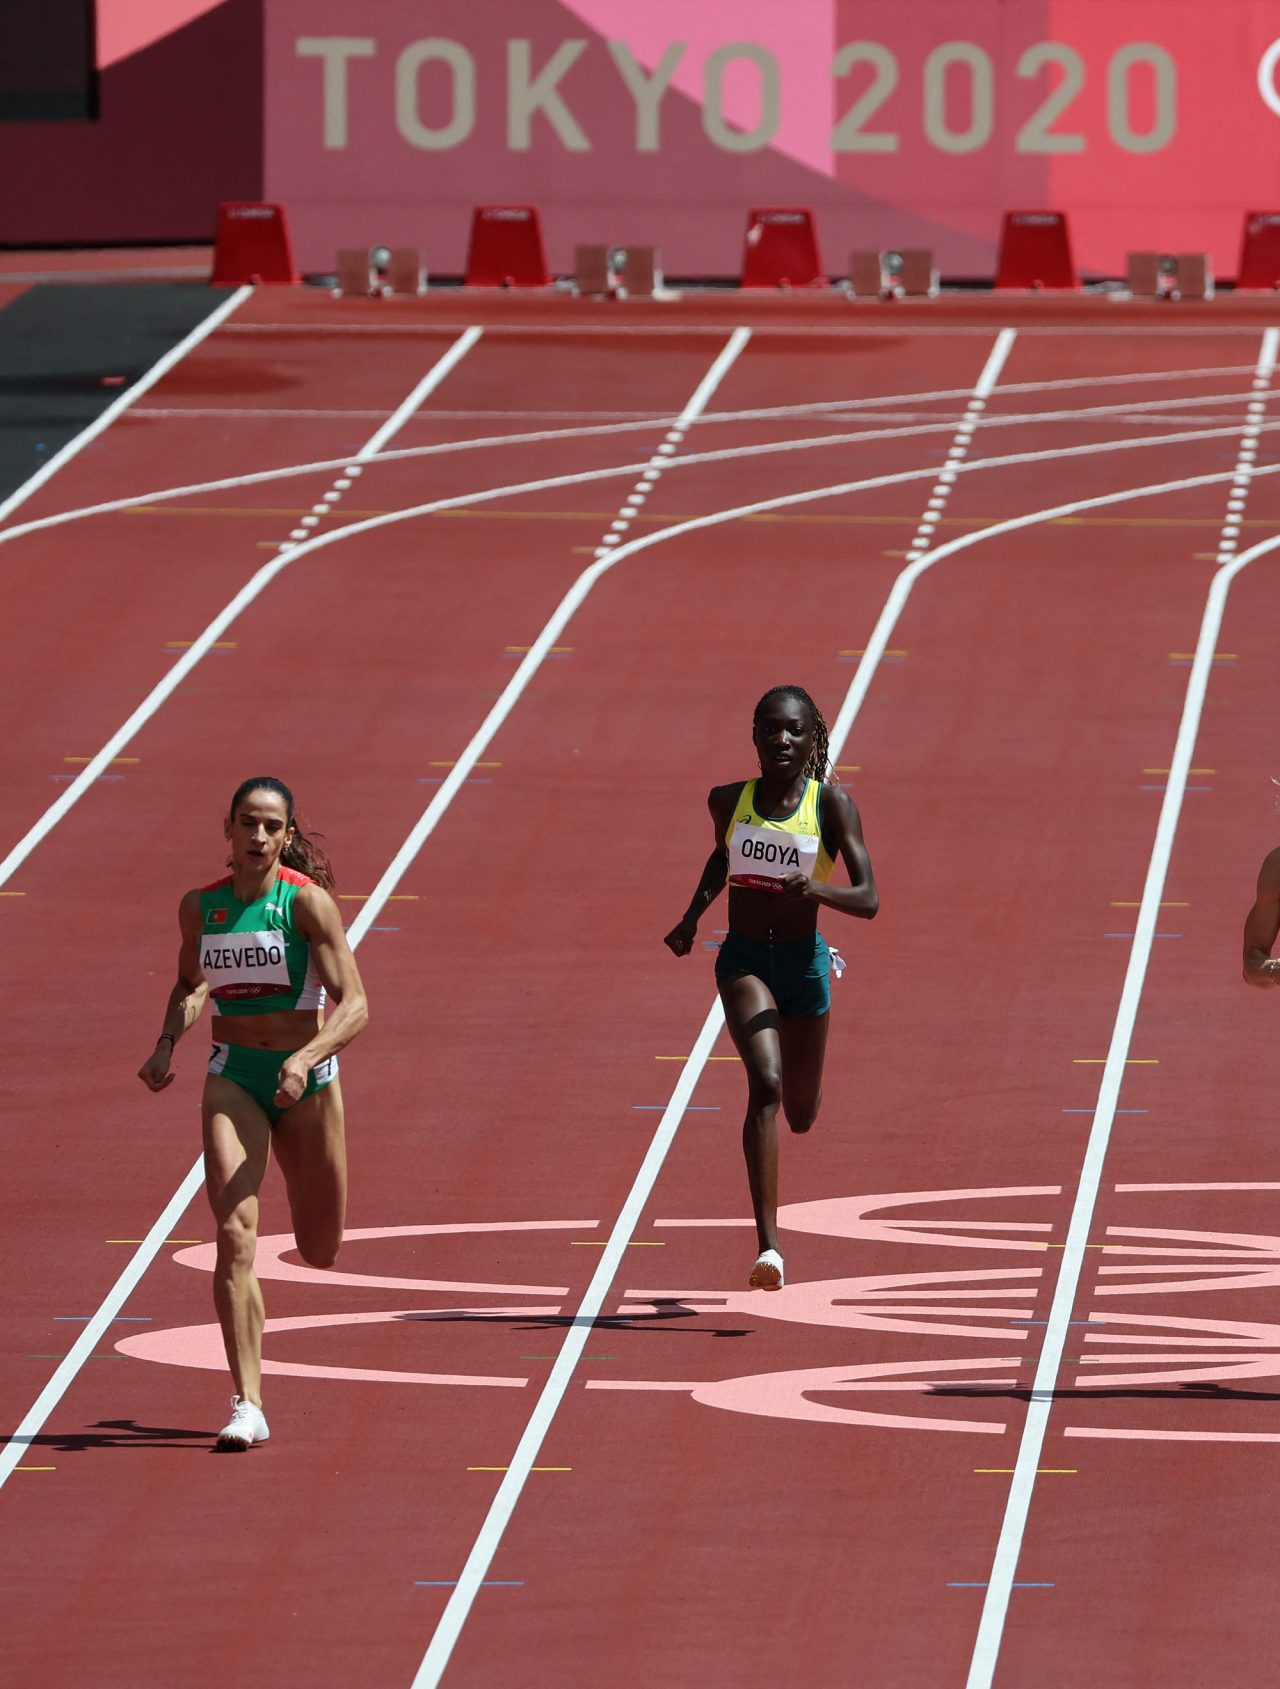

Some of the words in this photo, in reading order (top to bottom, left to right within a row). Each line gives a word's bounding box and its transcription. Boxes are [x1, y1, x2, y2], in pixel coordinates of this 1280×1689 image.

[295, 36, 781, 153] TOKYO
[829, 42, 1177, 154] 2020
[741, 838, 800, 868] OBOYA
[203, 945, 282, 970] AZEVEDO
